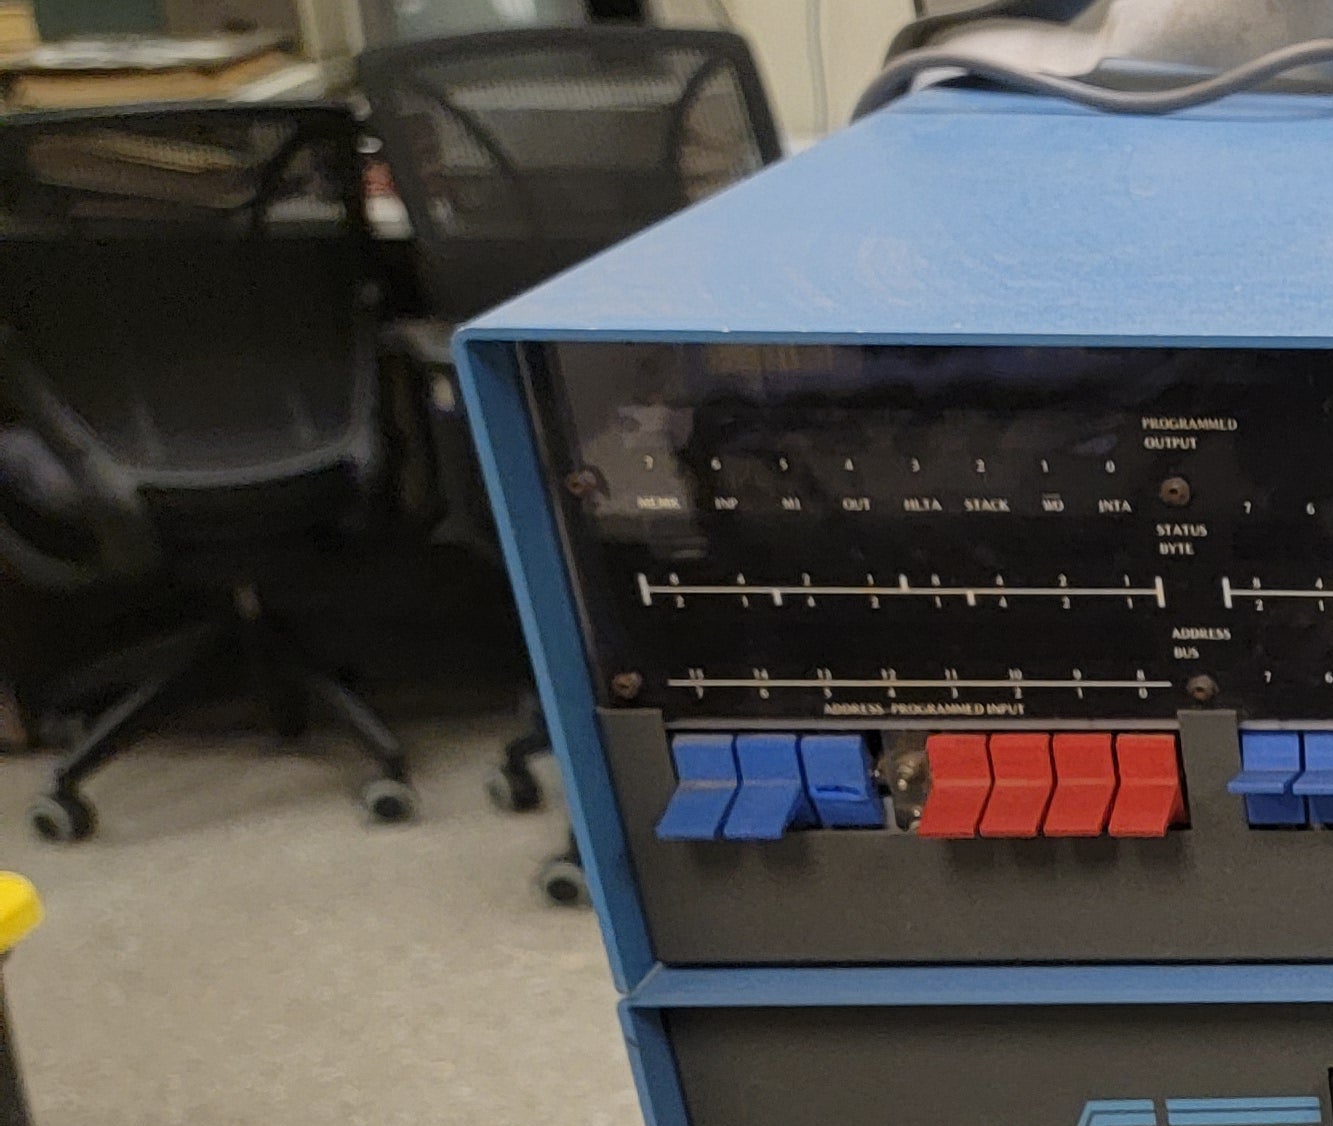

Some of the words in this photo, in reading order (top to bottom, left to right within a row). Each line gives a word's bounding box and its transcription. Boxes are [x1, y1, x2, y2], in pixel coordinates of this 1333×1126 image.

[1141, 416, 1238, 431] PROGRAMMED
[1144, 436, 1198, 450] OUTPUT
[1041, 459, 1049, 473] 1
[1105, 459, 1116, 473] 0
[963, 498, 1011, 513] STACK
[1098, 499, 1133, 513] INTA
[1243, 501, 1251, 514] 7
[1306, 502, 1315, 515] 6
[1156, 523, 1208, 537] STATUS
[1159, 541, 1195, 555] BYTE
[1124, 574, 1131, 587] 1
[1315, 577, 1323, 590] 4
[1127, 596, 1134, 609] 1
[1255, 599, 1264, 611] 2
[1318, 599, 1325, 612] 1
[1171, 627, 1231, 640] ADDRESS
[1173, 646, 1199, 659] BUS
[1008, 668, 1023, 680] 10
[1264, 671, 1272, 684] 7
[1324, 671, 1333, 684] 6
[1077, 686, 1084, 699] 1
[1139, 686, 1148, 699] 0
[987, 702, 1024, 715] INPUT
